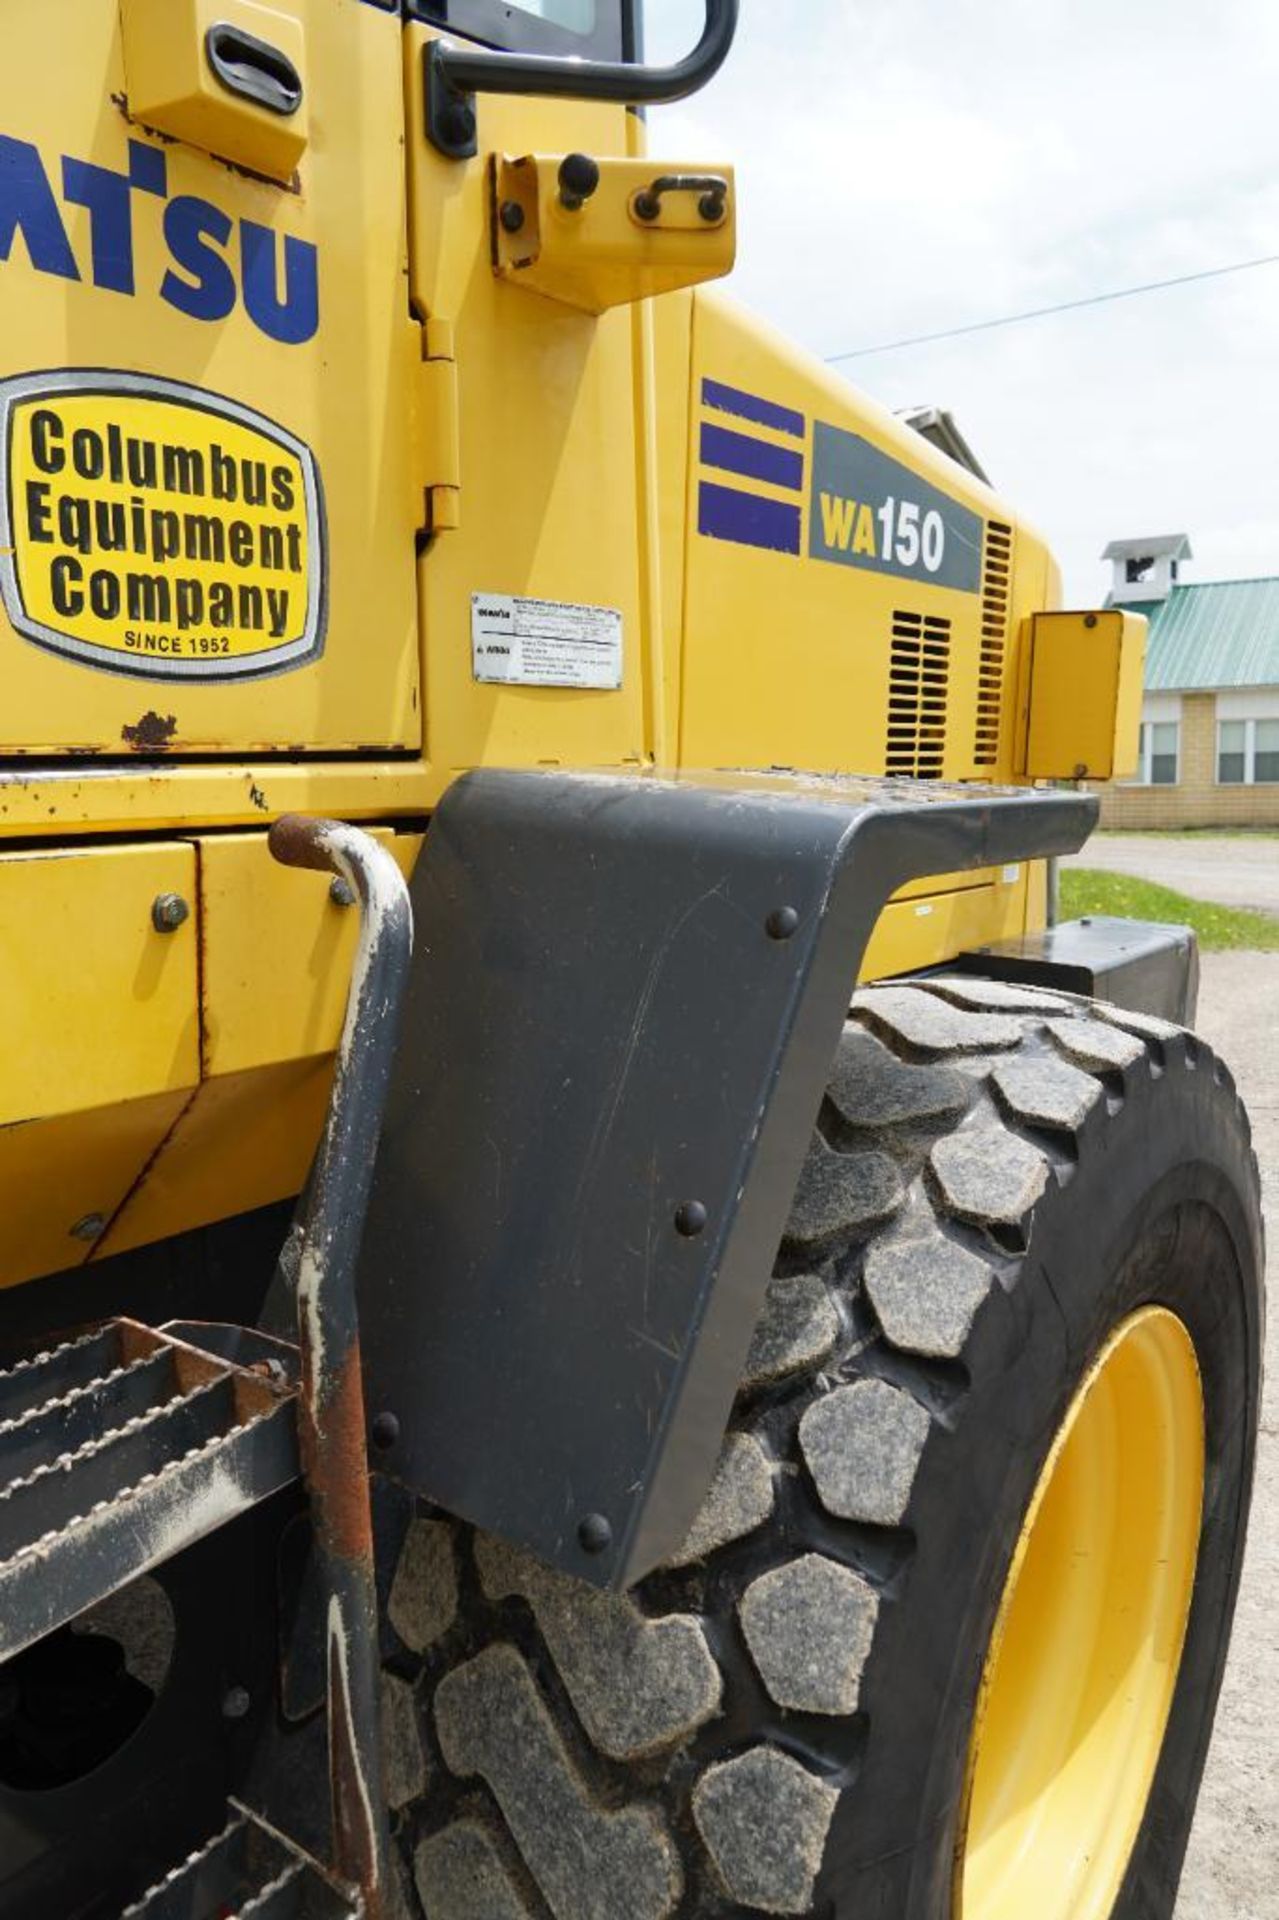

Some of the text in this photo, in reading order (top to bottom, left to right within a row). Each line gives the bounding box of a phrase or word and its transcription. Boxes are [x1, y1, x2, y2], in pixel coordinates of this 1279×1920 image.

[0, 134, 319, 345] ATSU
[30, 409, 294, 512] Columbus
[26, 480, 302, 573] Equipment
[819, 491, 945, 572] WA150
[50, 555, 289, 637] Company
[124, 631, 230, 653] SINCE 1952
